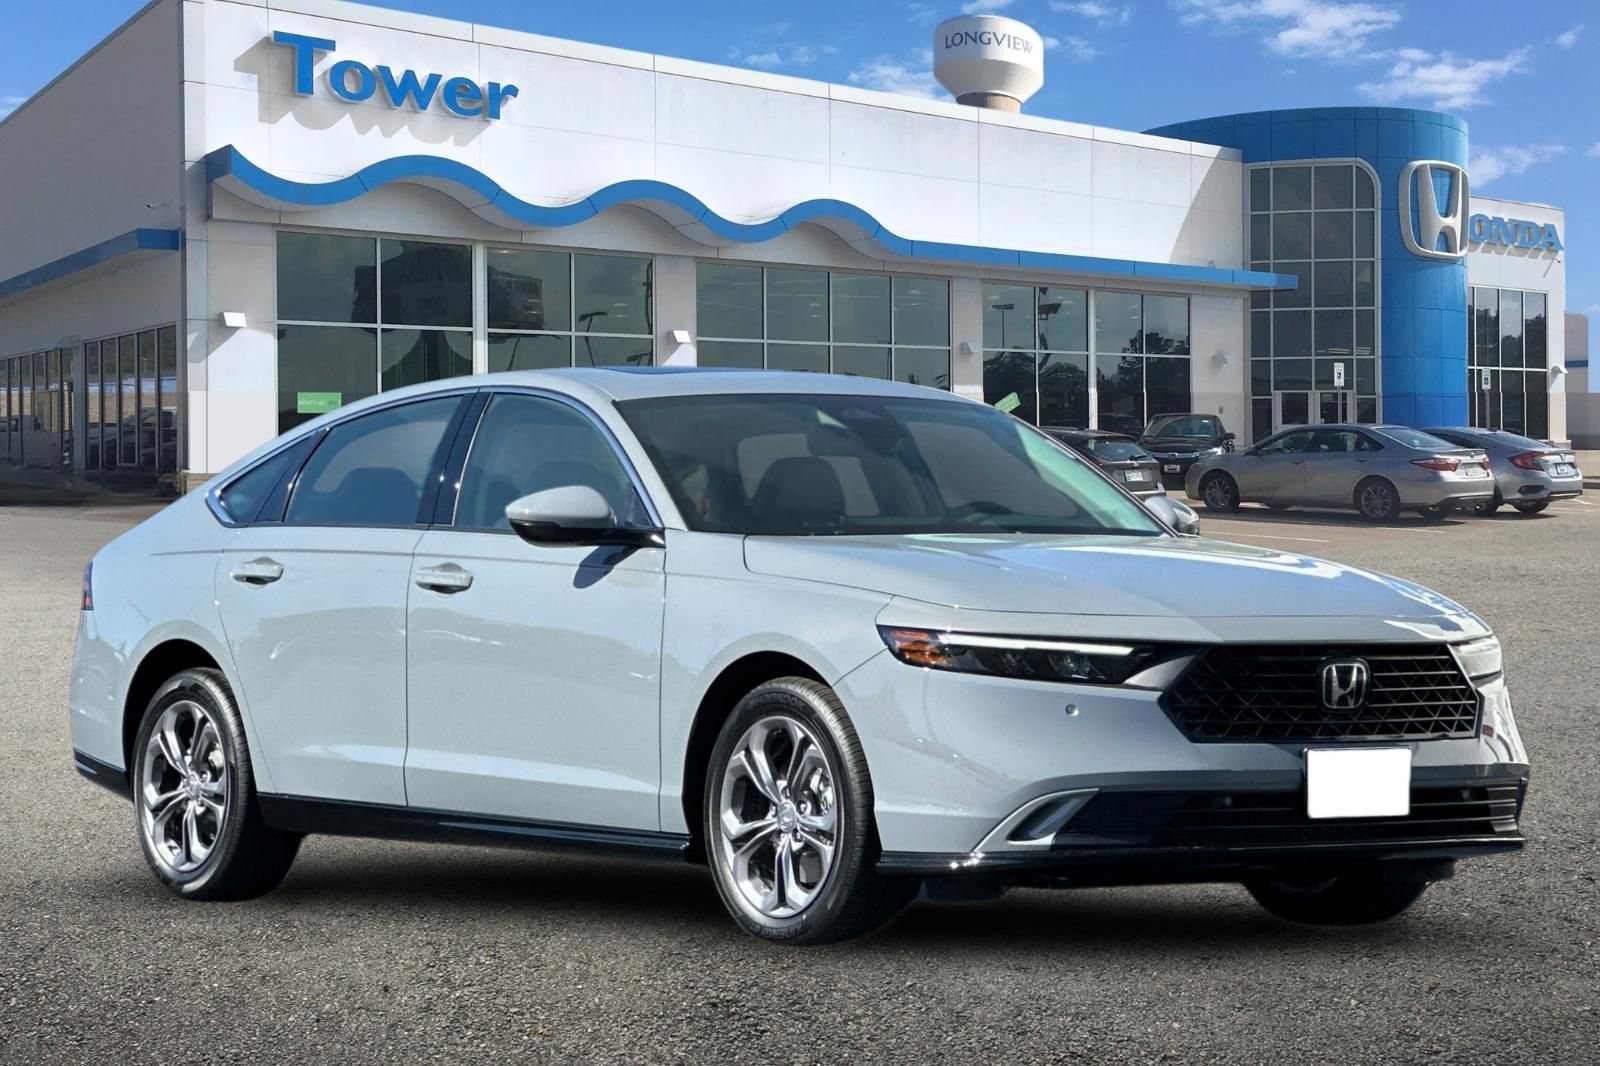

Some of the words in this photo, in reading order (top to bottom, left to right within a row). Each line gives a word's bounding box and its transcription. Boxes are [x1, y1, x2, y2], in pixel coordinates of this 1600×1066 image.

[945, 31, 1033, 54] LONGVIEW
[273, 30, 520, 121] Tower
[1469, 213, 1564, 250] ONDA
